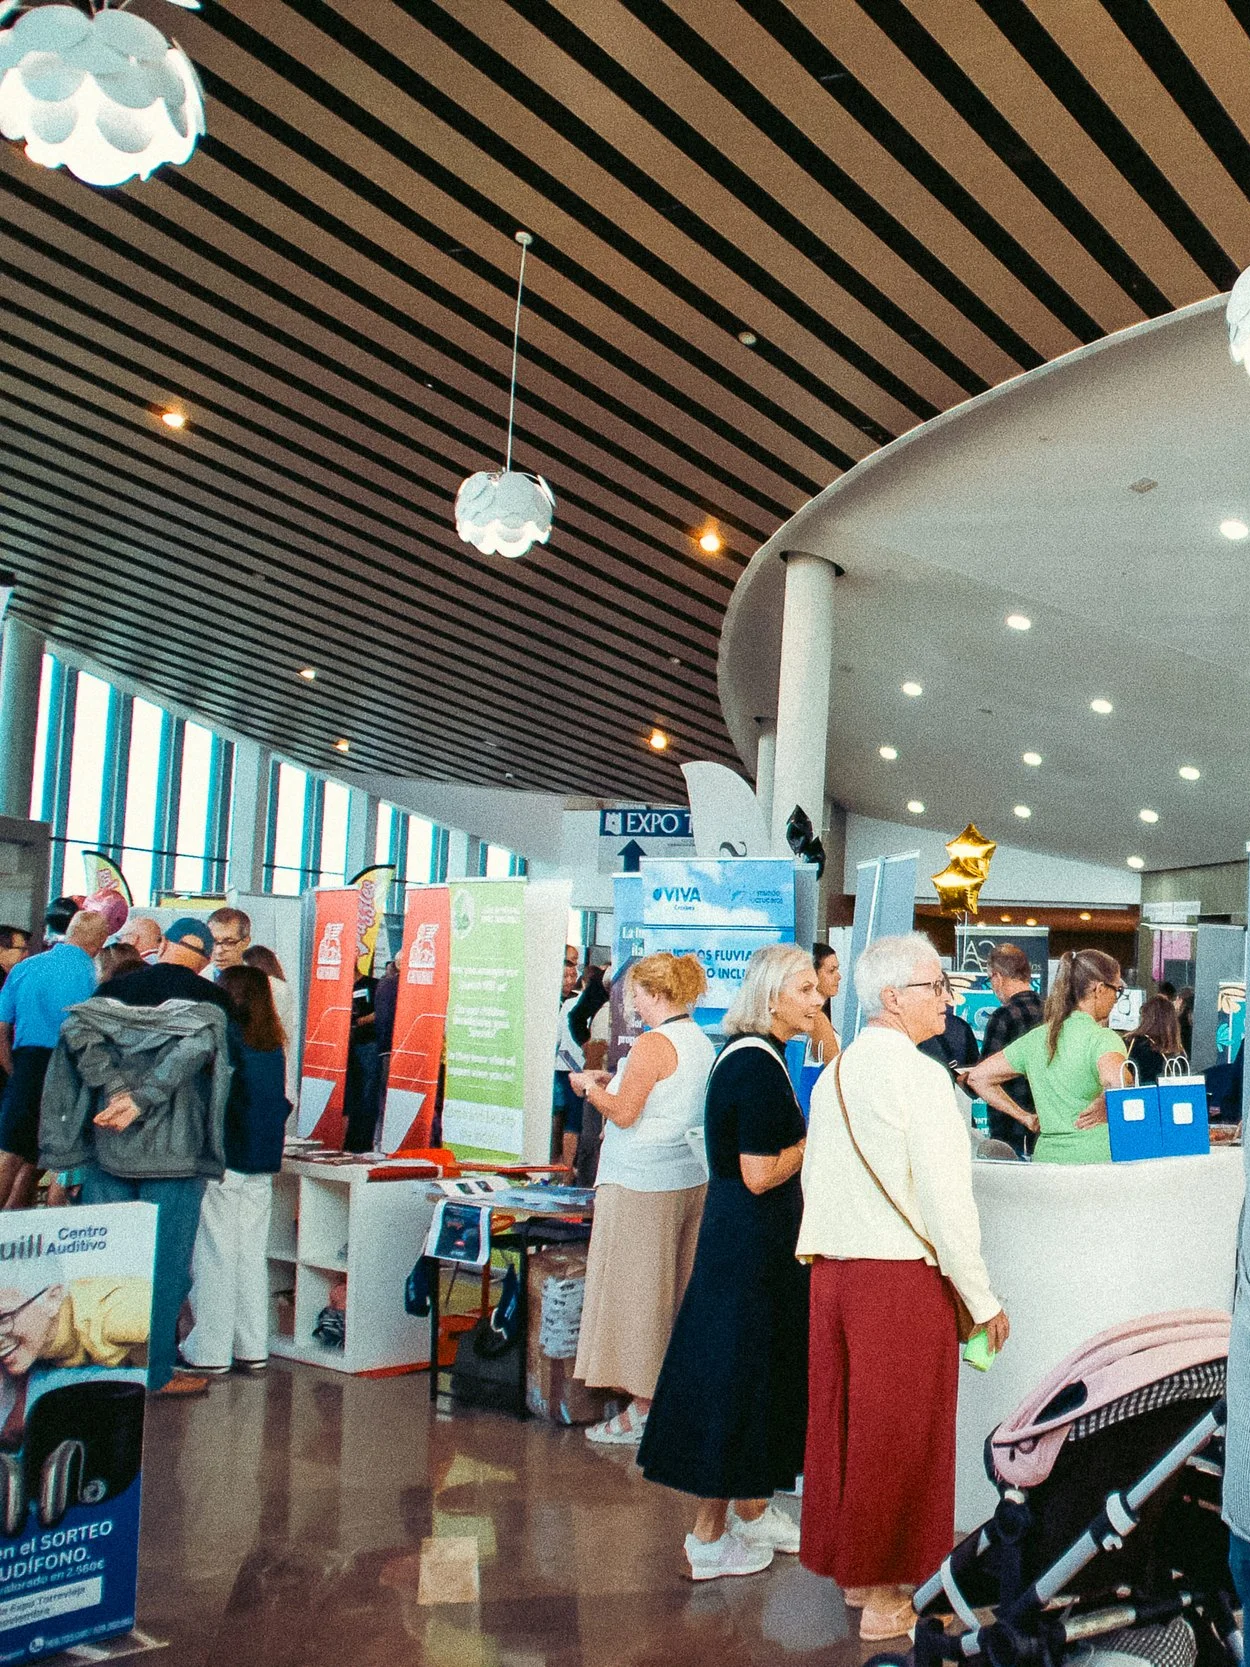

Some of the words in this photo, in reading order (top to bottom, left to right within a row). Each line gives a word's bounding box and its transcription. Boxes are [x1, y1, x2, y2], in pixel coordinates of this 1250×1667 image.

[626, 812, 679, 834] EXPO
[664, 886, 702, 903] VIVA
[718, 967, 746, 980] INCL
[58, 1225, 108, 1241] Centro
[45, 1239, 107, 1256] Auditivo
[20, 1537, 36, 1556] el
[40, 1520, 113, 1551] SORTEO
